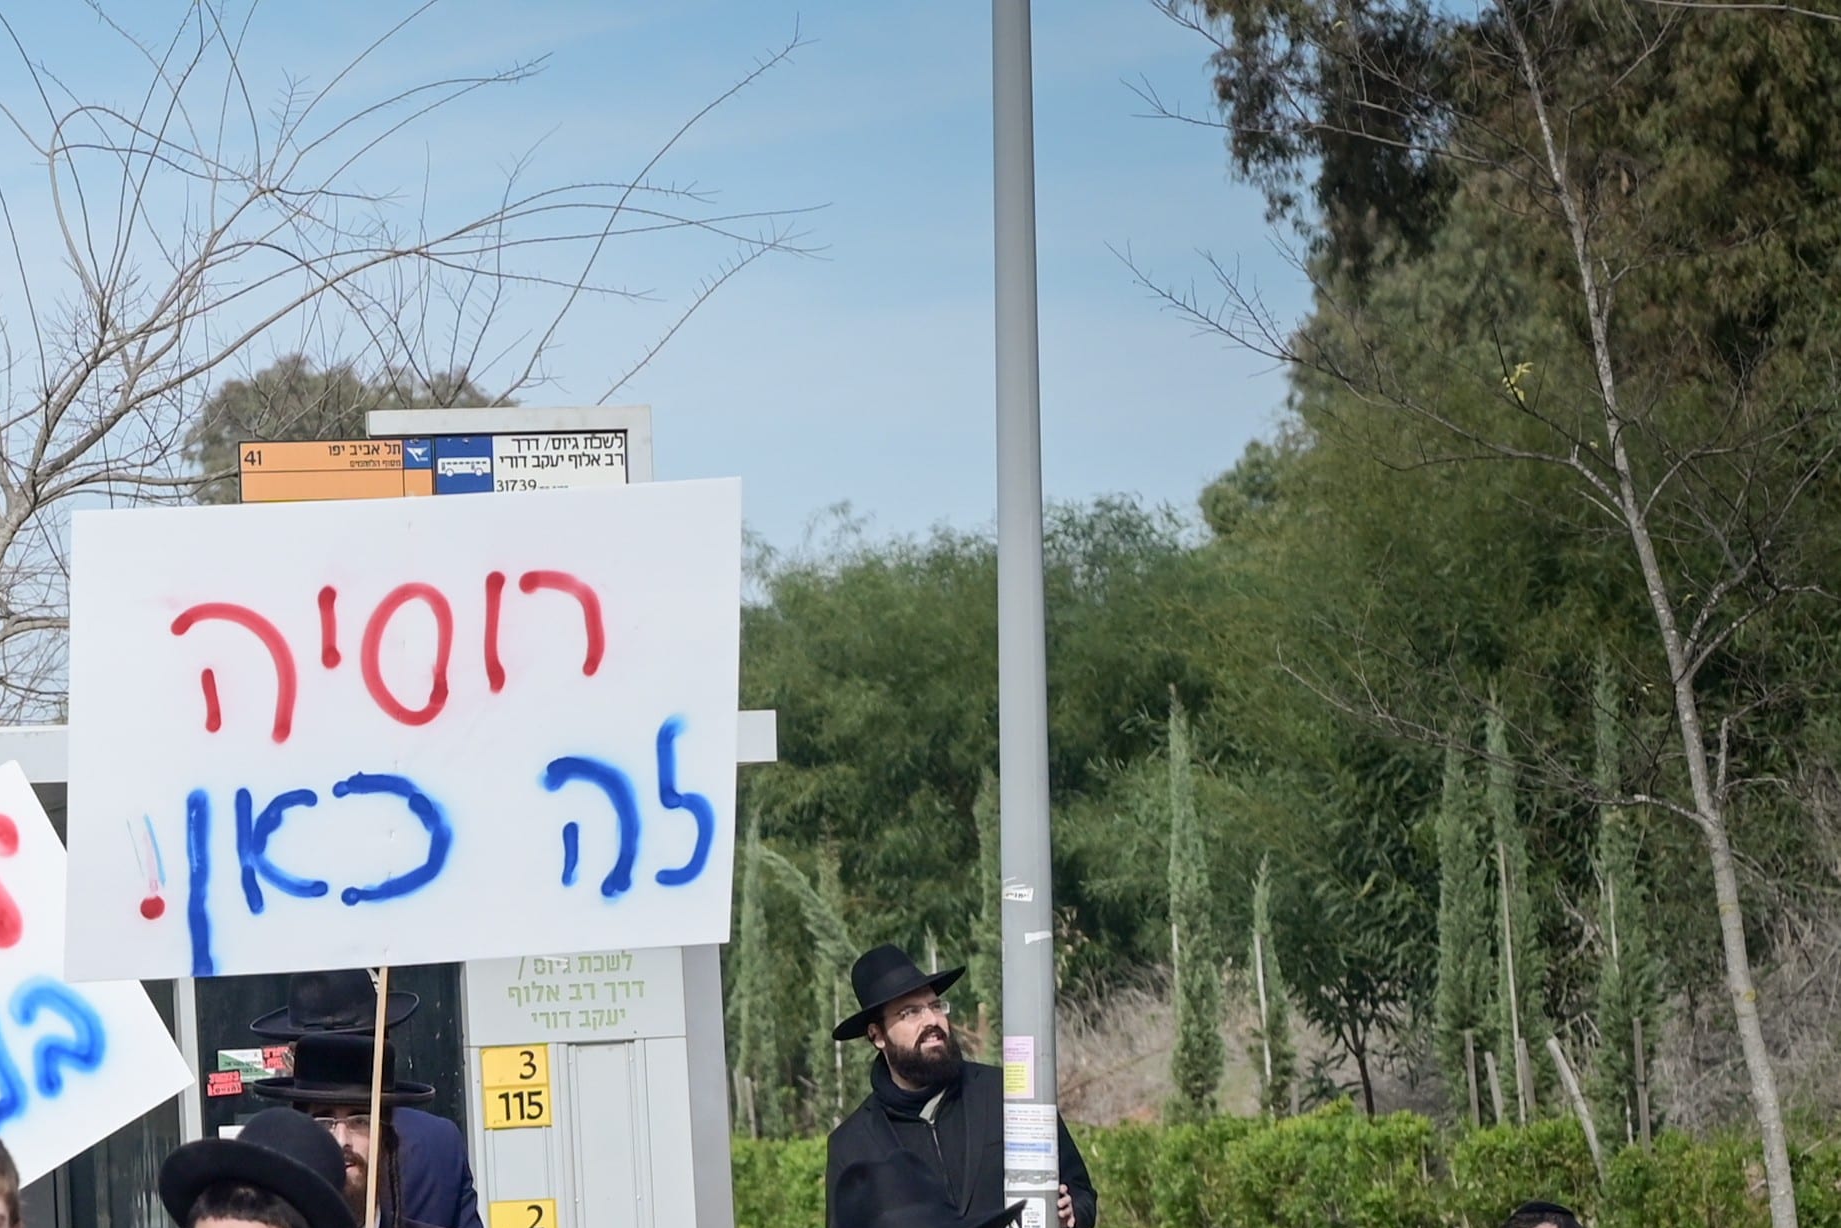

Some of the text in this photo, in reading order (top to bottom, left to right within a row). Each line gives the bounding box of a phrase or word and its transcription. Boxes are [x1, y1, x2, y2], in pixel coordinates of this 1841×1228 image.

[328, 442, 401, 457] תל אביב יפו
[511, 438, 540, 454] דרך
[584, 433, 624, 449] לשכת
[244, 450, 262, 467] 41
[499, 451, 624, 470] רב אלוף יעקב דורי
[496, 479, 537, 493] 31739
[171, 570, 605, 744] רוסיה
[578, 950, 633, 973] לשכת
[508, 980, 645, 1008] דרך רב אלוף
[531, 1008, 626, 1031] יעקב דורי
[519, 1050, 538, 1081] 3
[498, 1090, 545, 1123] 115
